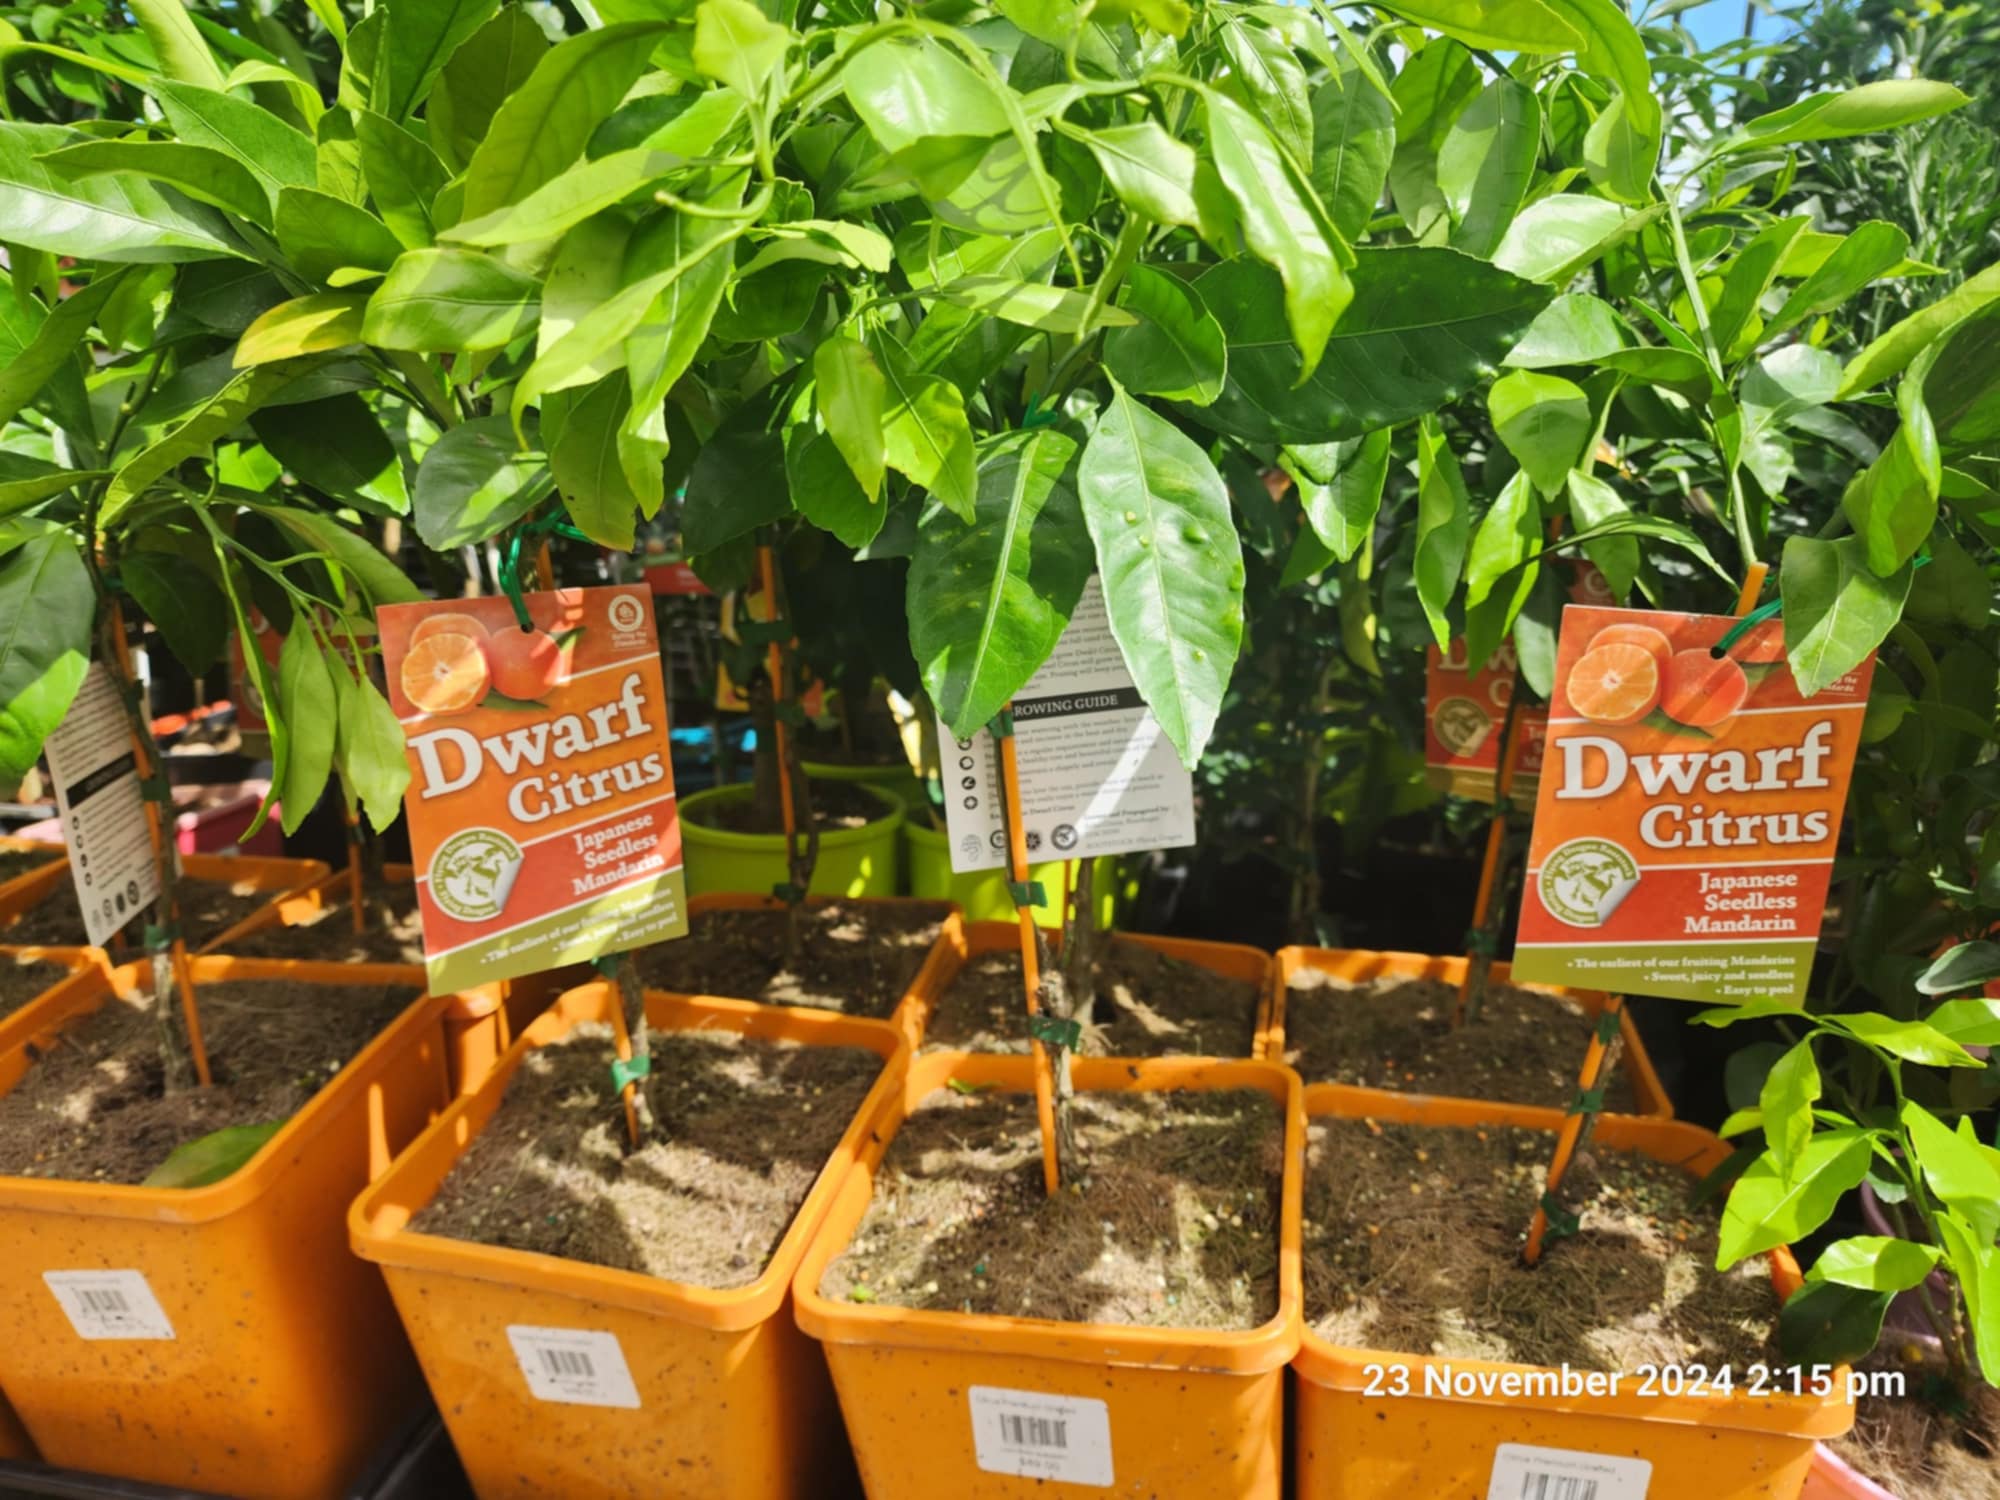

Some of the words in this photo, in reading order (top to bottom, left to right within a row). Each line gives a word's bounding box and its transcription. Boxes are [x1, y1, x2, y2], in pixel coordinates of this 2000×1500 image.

[1012, 699, 1073, 717] ROWING
[1074, 694, 1119, 710] GUIDE
[407, 673, 653, 799] Dwarf
[1555, 722, 1832, 799] Dwarf
[508, 753, 664, 823] Citrus
[573, 814, 654, 854] Japanese
[1640, 804, 1829, 849] Citrus
[584, 833, 659, 869] Seedless
[572, 854, 664, 896] Mandarin
[1698, 872, 1798, 893] Japanese
[1704, 893, 1798, 911] Seedless
[1684, 915, 1797, 934] Mandarin
[1574, 958, 1598, 968] The
[1643, 958, 1657, 967] of
[1658, 959, 1679, 967] our
[1691, 971, 1721, 983] juicy
[1723, 971, 1745, 981] and
[1748, 970, 1795, 980] seedless
[1723, 985, 1751, 996] Easy
[1753, 985, 1766, 995] to
[1768, 984, 1794, 996] peel
